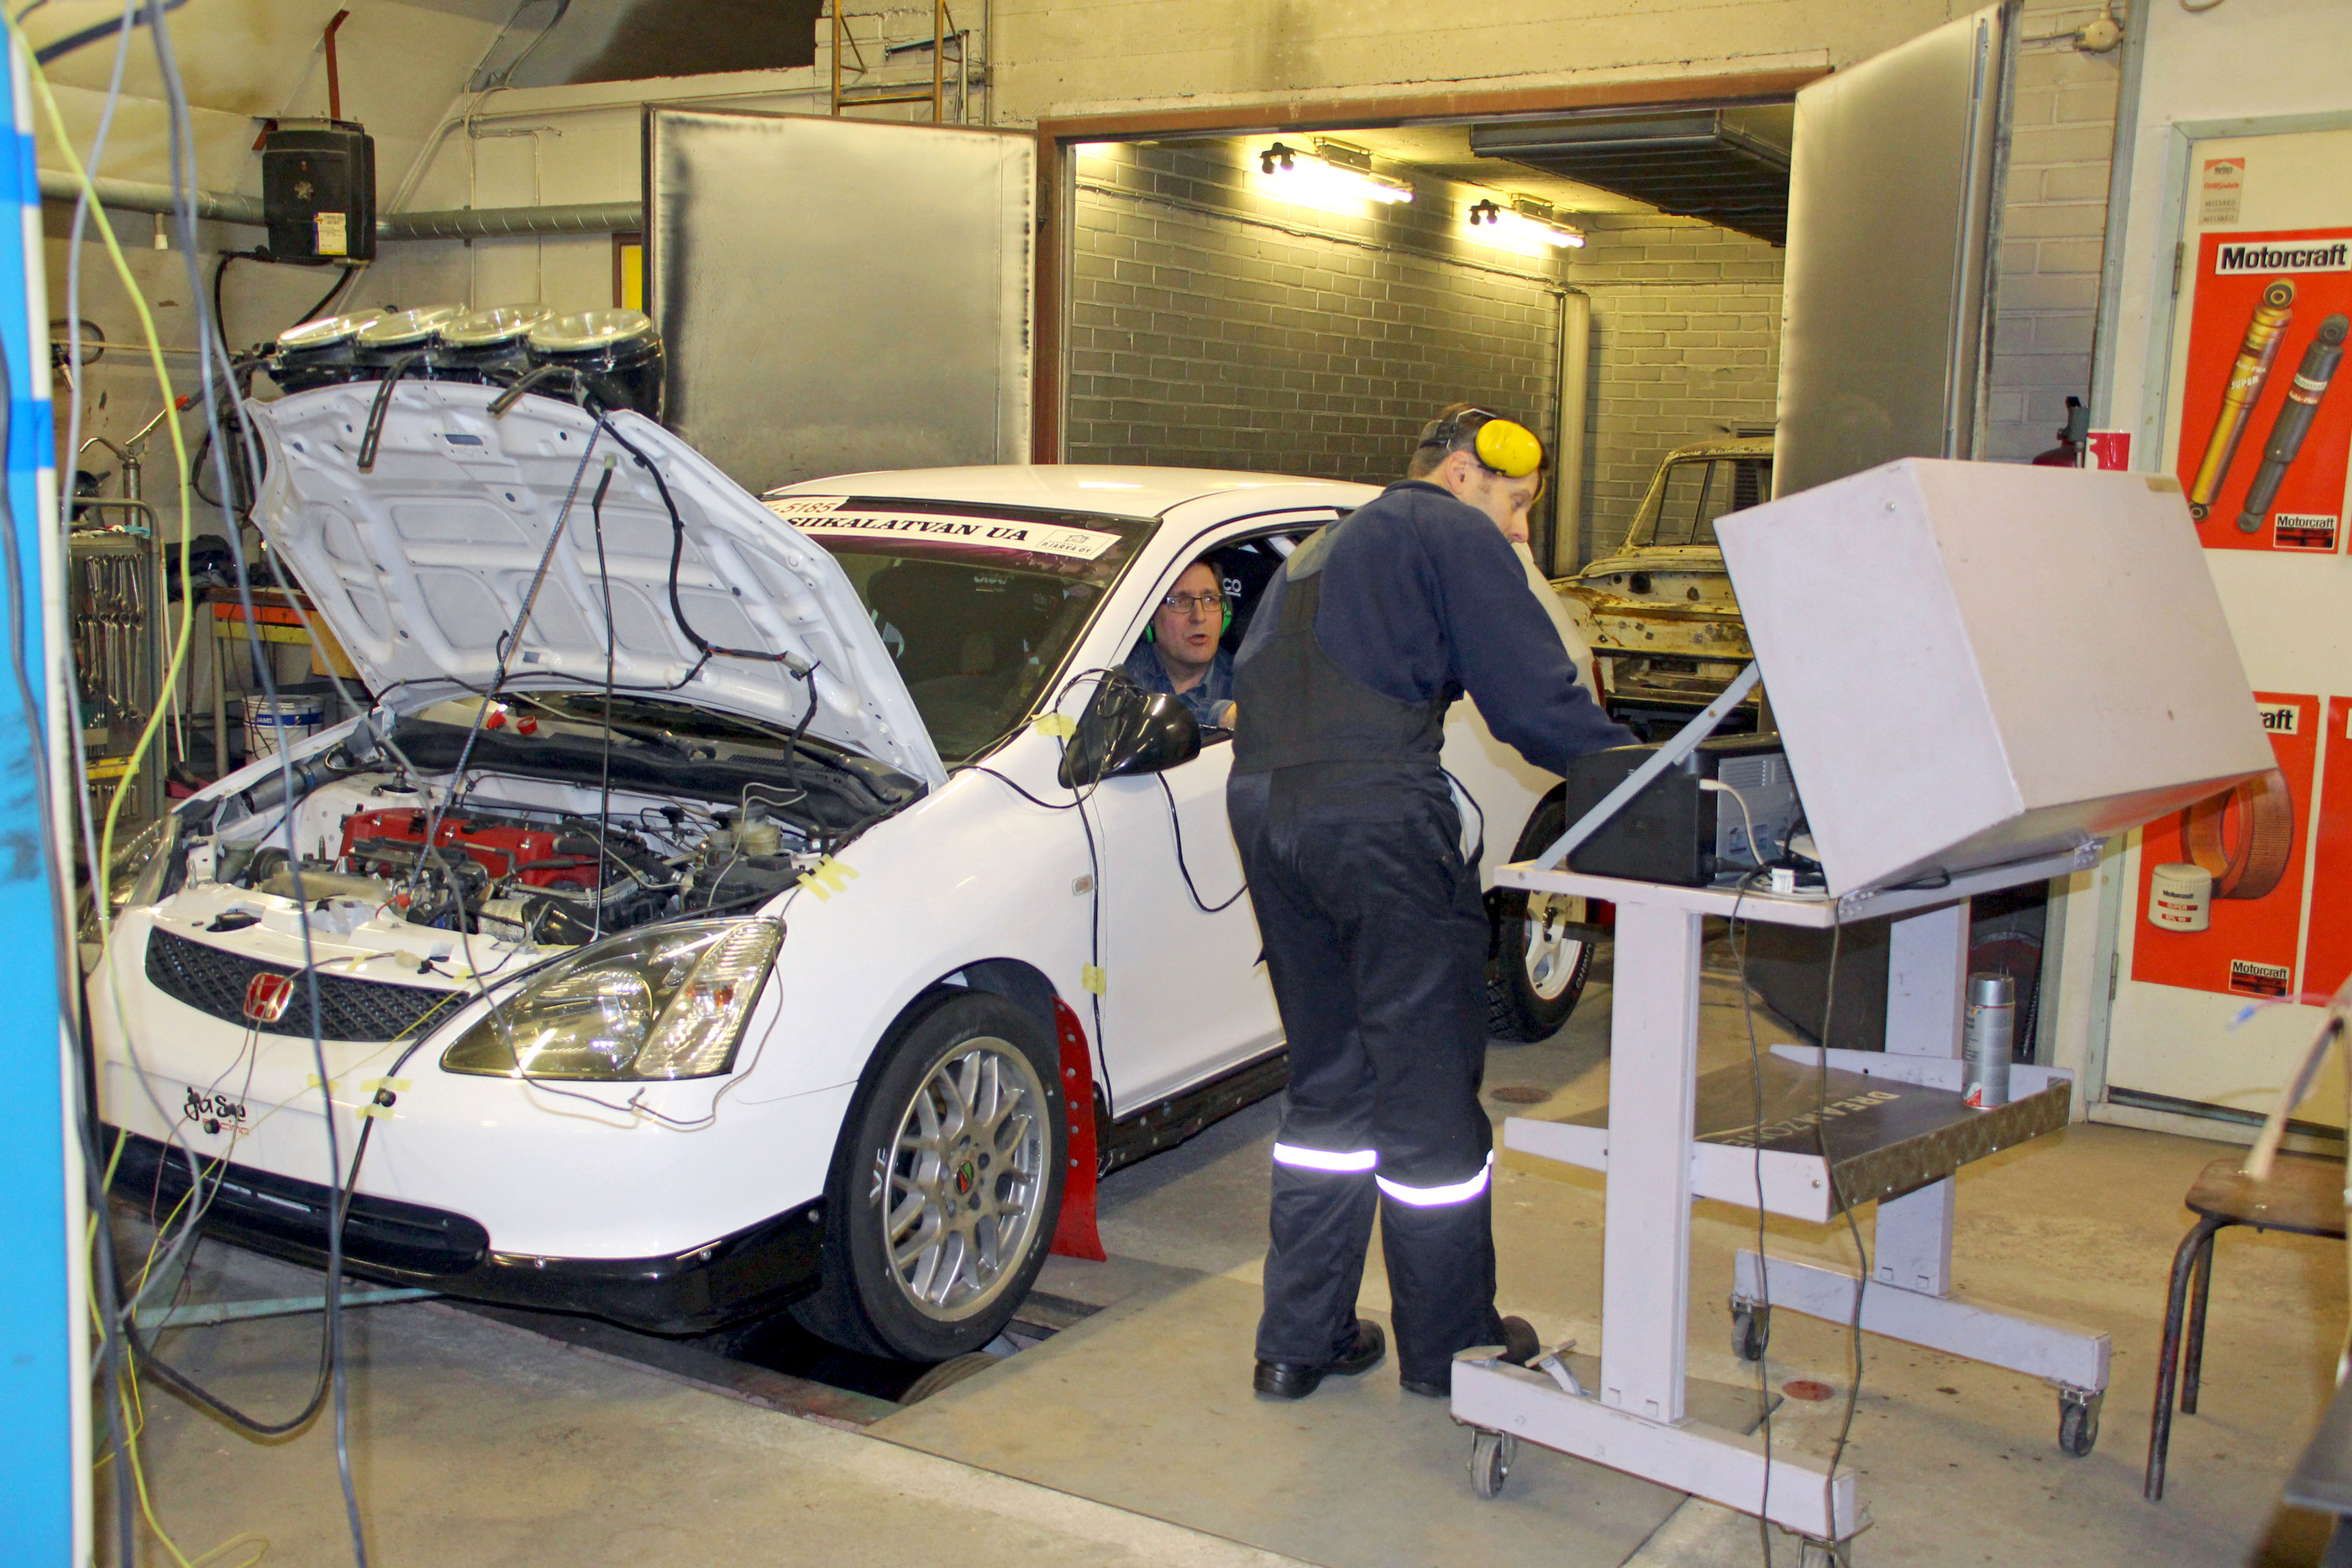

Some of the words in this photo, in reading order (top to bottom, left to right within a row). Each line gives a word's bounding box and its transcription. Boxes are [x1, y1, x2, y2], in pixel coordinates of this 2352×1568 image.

[2221, 244, 2347, 270] Motorcraft
[2231, 375, 2259, 390] SUPER
[787, 517, 983, 537] SIIKALATVAN
[986, 527, 1029, 542] UA
[2276, 516, 2334, 528] Motorcraft
[2260, 709, 2293, 730] aft
[2233, 961, 2286, 978] Motorcraft
[1722, 1090, 1901, 1147] DREAMZONE
